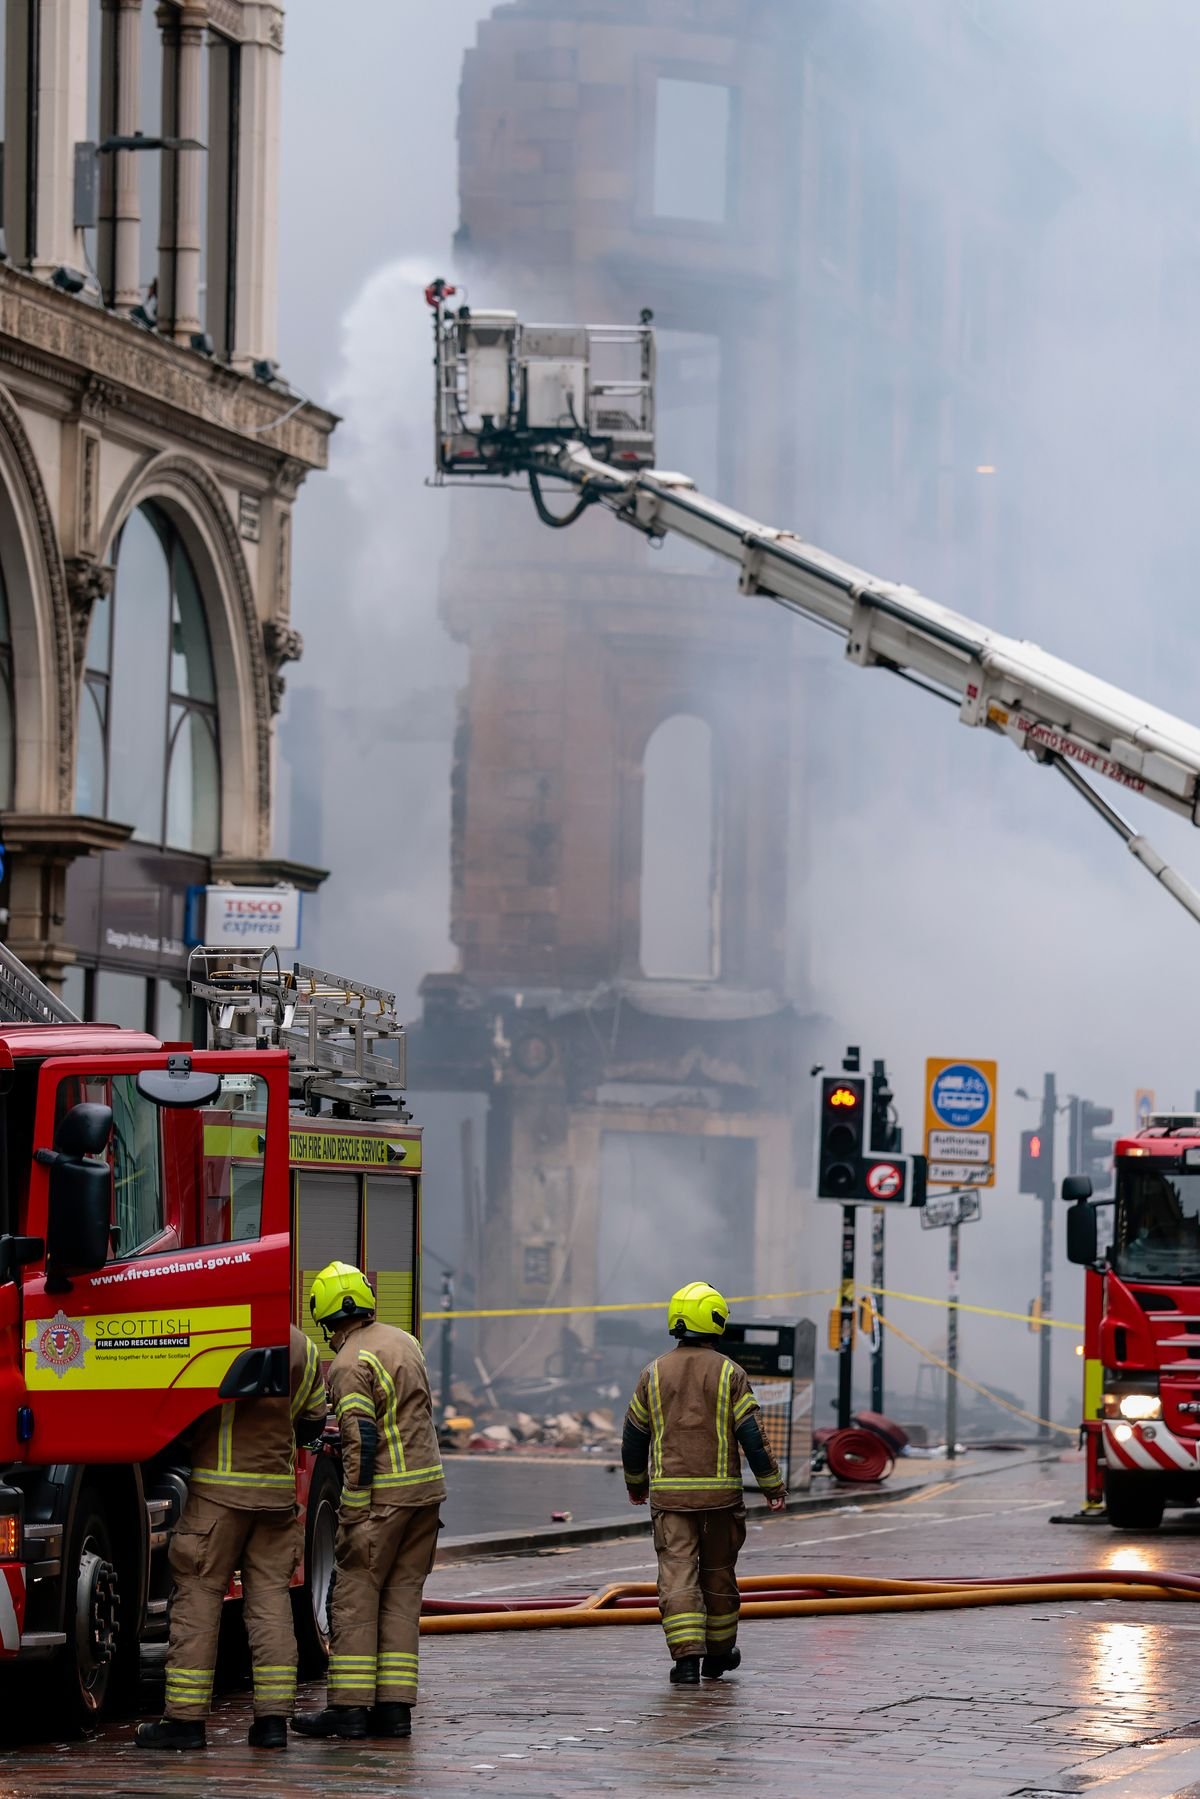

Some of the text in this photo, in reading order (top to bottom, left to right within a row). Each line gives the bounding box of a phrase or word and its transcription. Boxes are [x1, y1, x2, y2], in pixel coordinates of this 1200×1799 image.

[224, 900, 282, 913] TESCO
[223, 921, 280, 935] express
[308, 1136, 321, 1159] FIRE
[322, 1137, 336, 1160] AND
[337, 1138, 360, 1161] RESCUE
[361, 1139, 385, 1163] SERVICE
[90, 1252, 251, 1286] www.firescotland.gov.uk
[95, 1319, 191, 1336] SCOTTISH
[97, 1340, 113, 1348] FIRE
